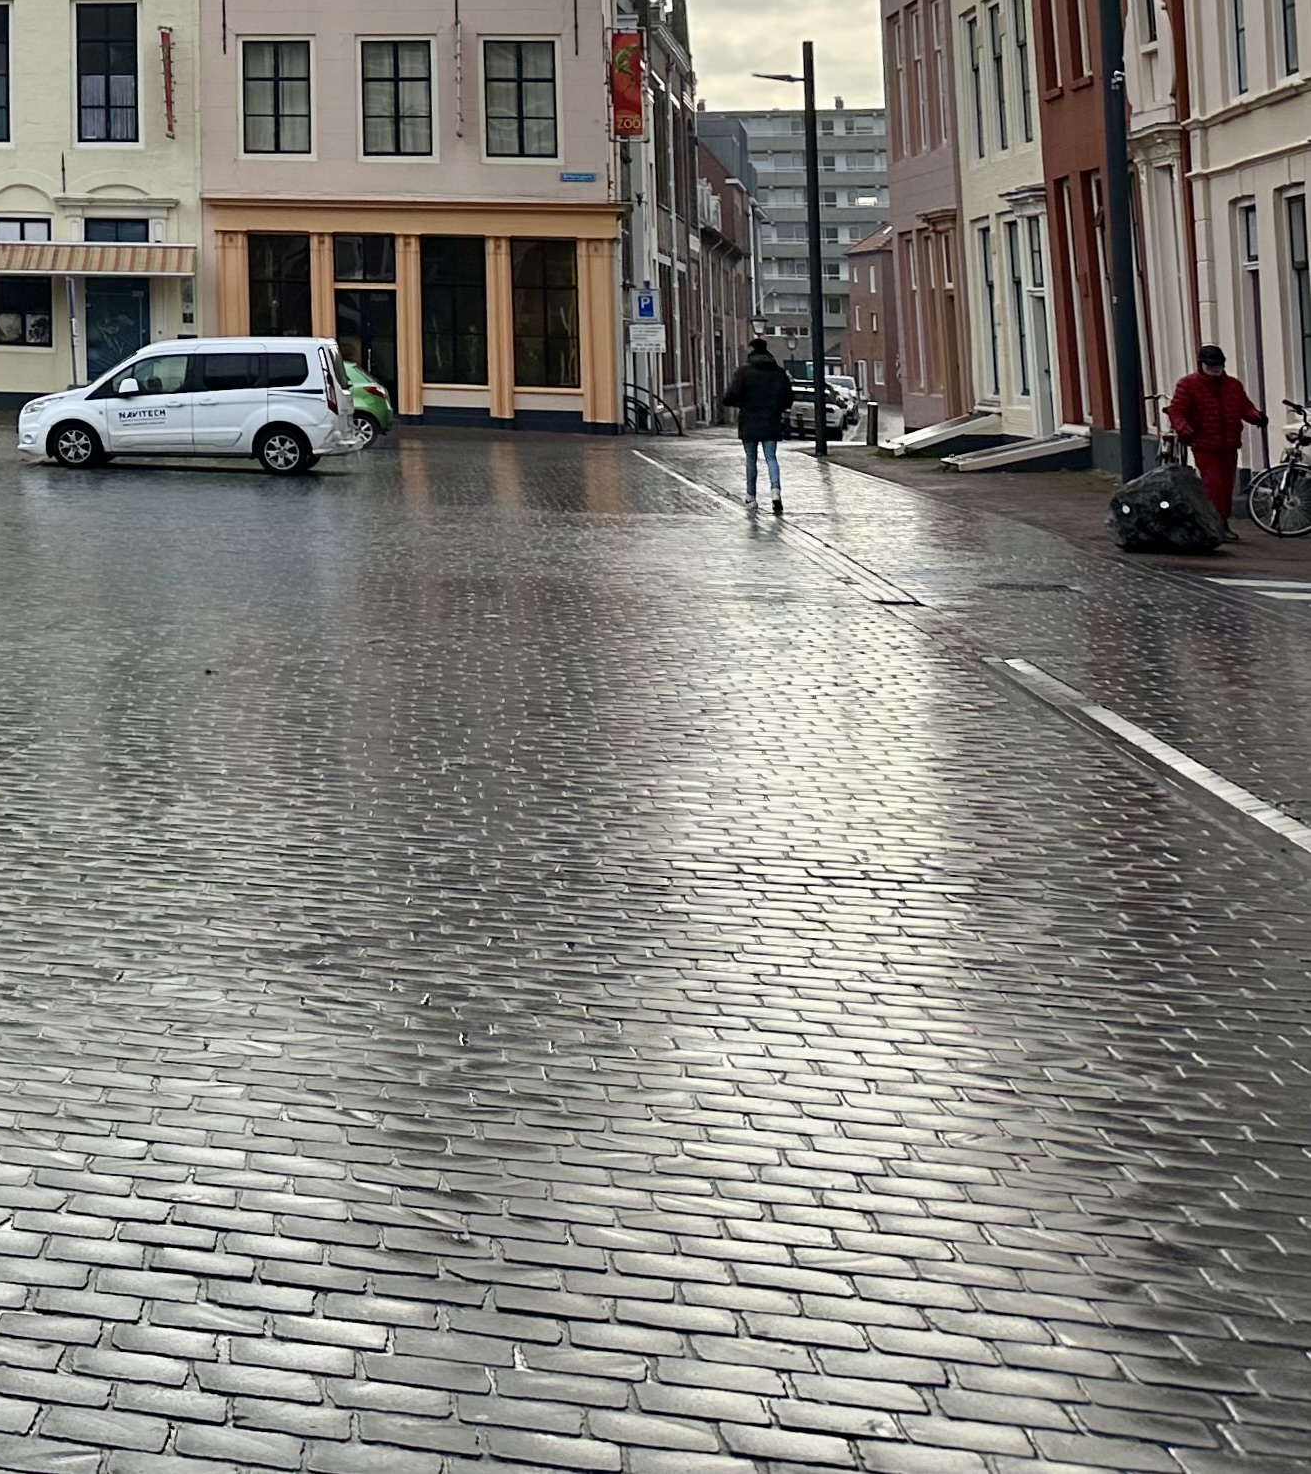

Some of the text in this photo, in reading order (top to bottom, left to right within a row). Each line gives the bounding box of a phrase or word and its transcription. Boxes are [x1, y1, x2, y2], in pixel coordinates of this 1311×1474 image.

[616, 118, 642, 129] ZOO
[640, 296, 651, 309] P
[119, 409, 166, 419] NAVITECH
